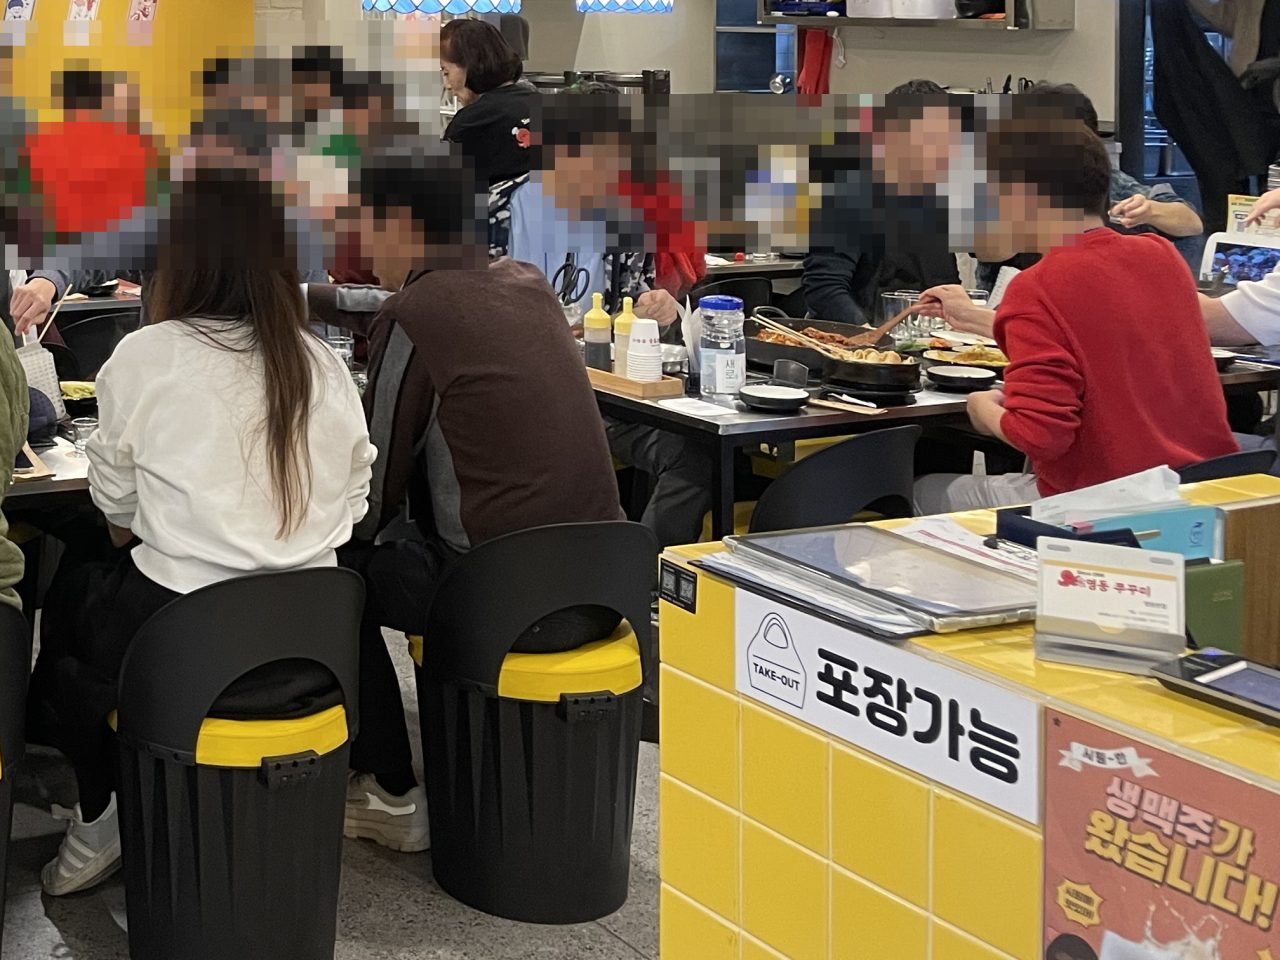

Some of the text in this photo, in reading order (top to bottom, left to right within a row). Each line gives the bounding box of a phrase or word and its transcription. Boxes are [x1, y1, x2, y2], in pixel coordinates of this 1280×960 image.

[1086, 577, 1110, 592] 명동
[753, 662, 801, 691] TAKE-OUT
[816, 647, 1020, 784] 포장가능
[1106, 776, 1255, 867] 생맥주가
[1085, 808, 1280, 930] 왔습니다!
